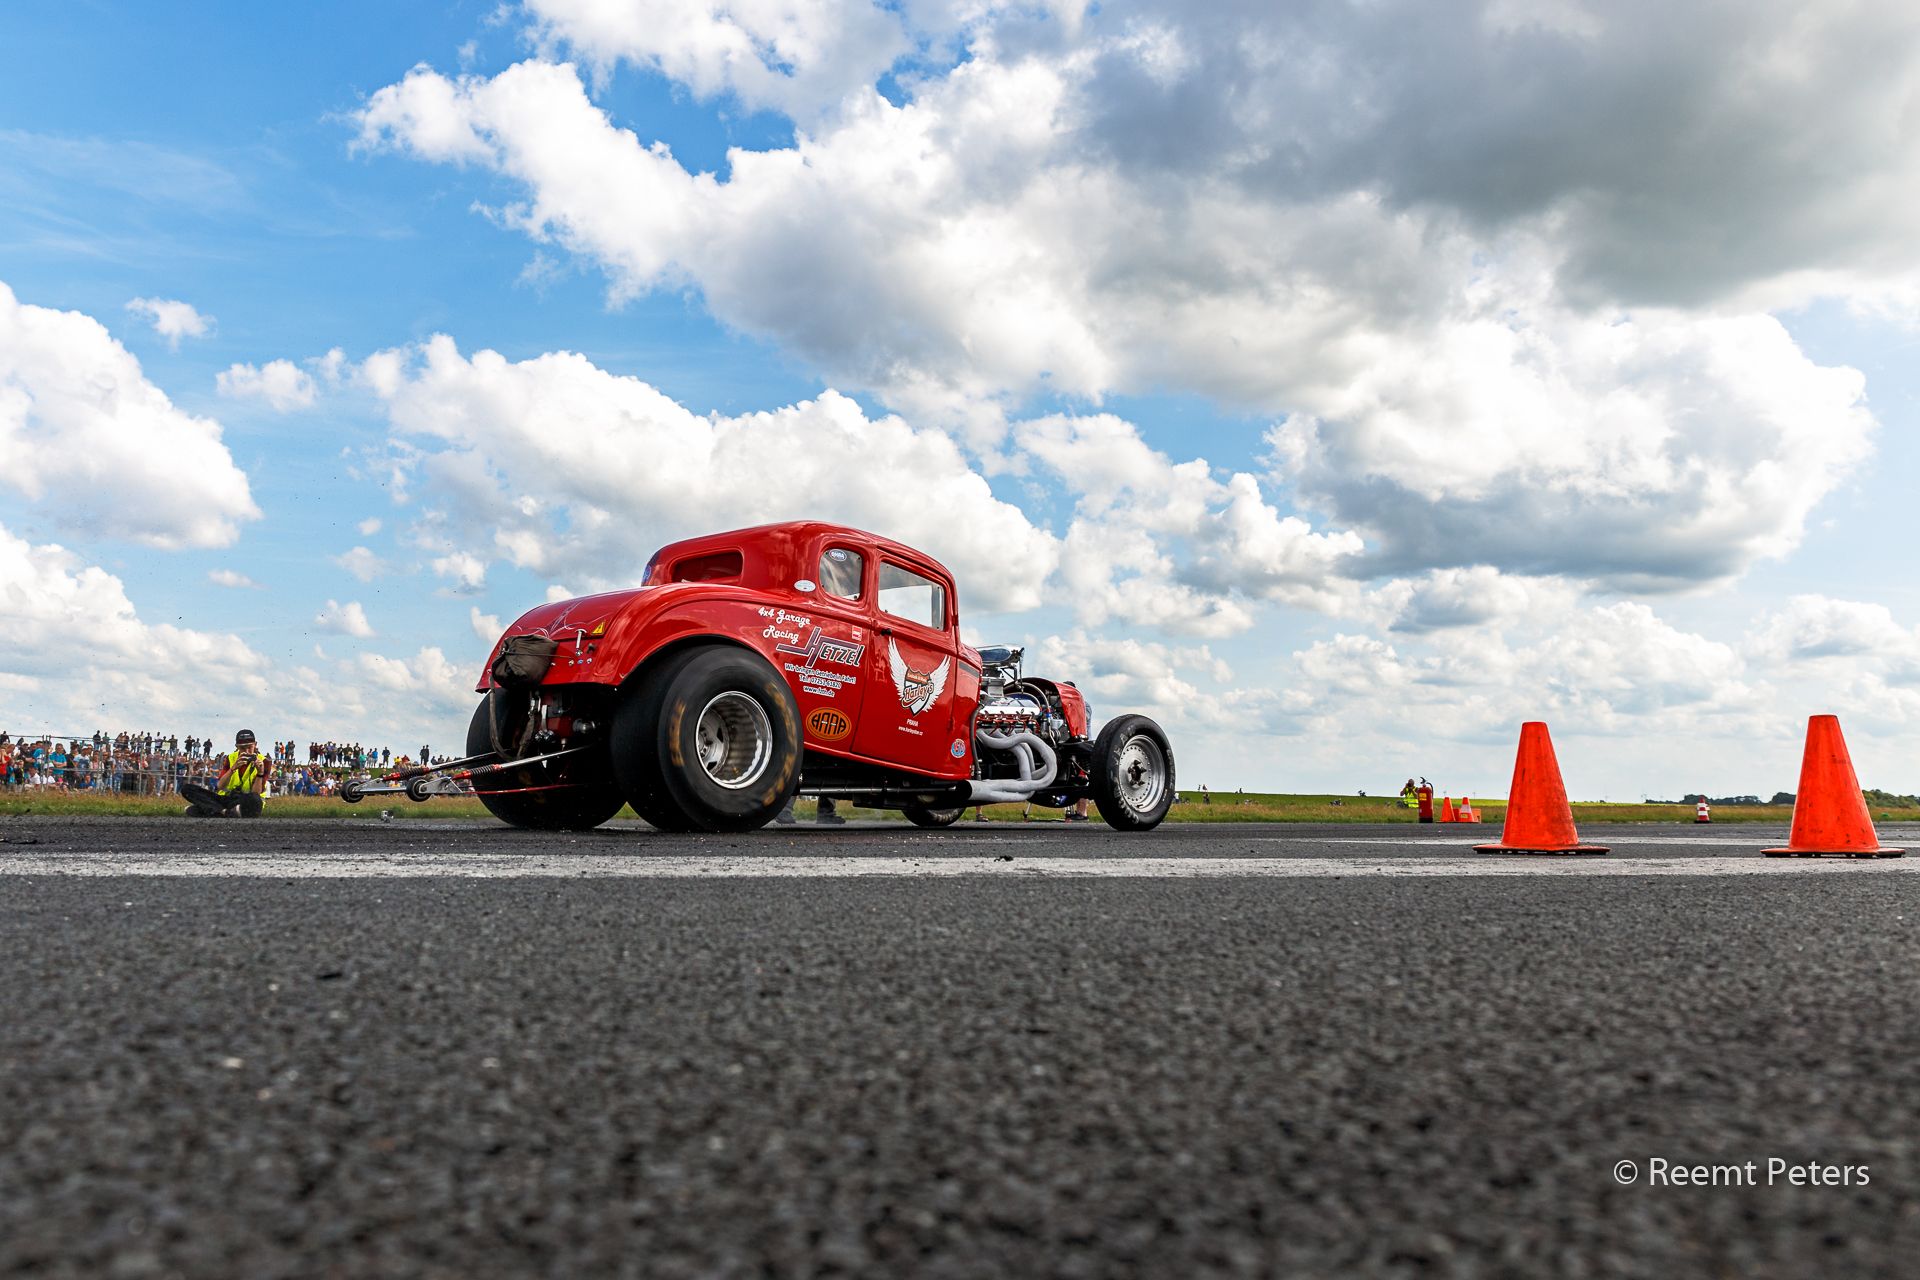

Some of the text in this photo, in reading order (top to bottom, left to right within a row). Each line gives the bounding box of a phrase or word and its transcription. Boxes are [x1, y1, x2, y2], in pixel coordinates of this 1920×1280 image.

[758, 606, 811, 628] 4x4 Garage
[762, 625, 800, 644] Racing
